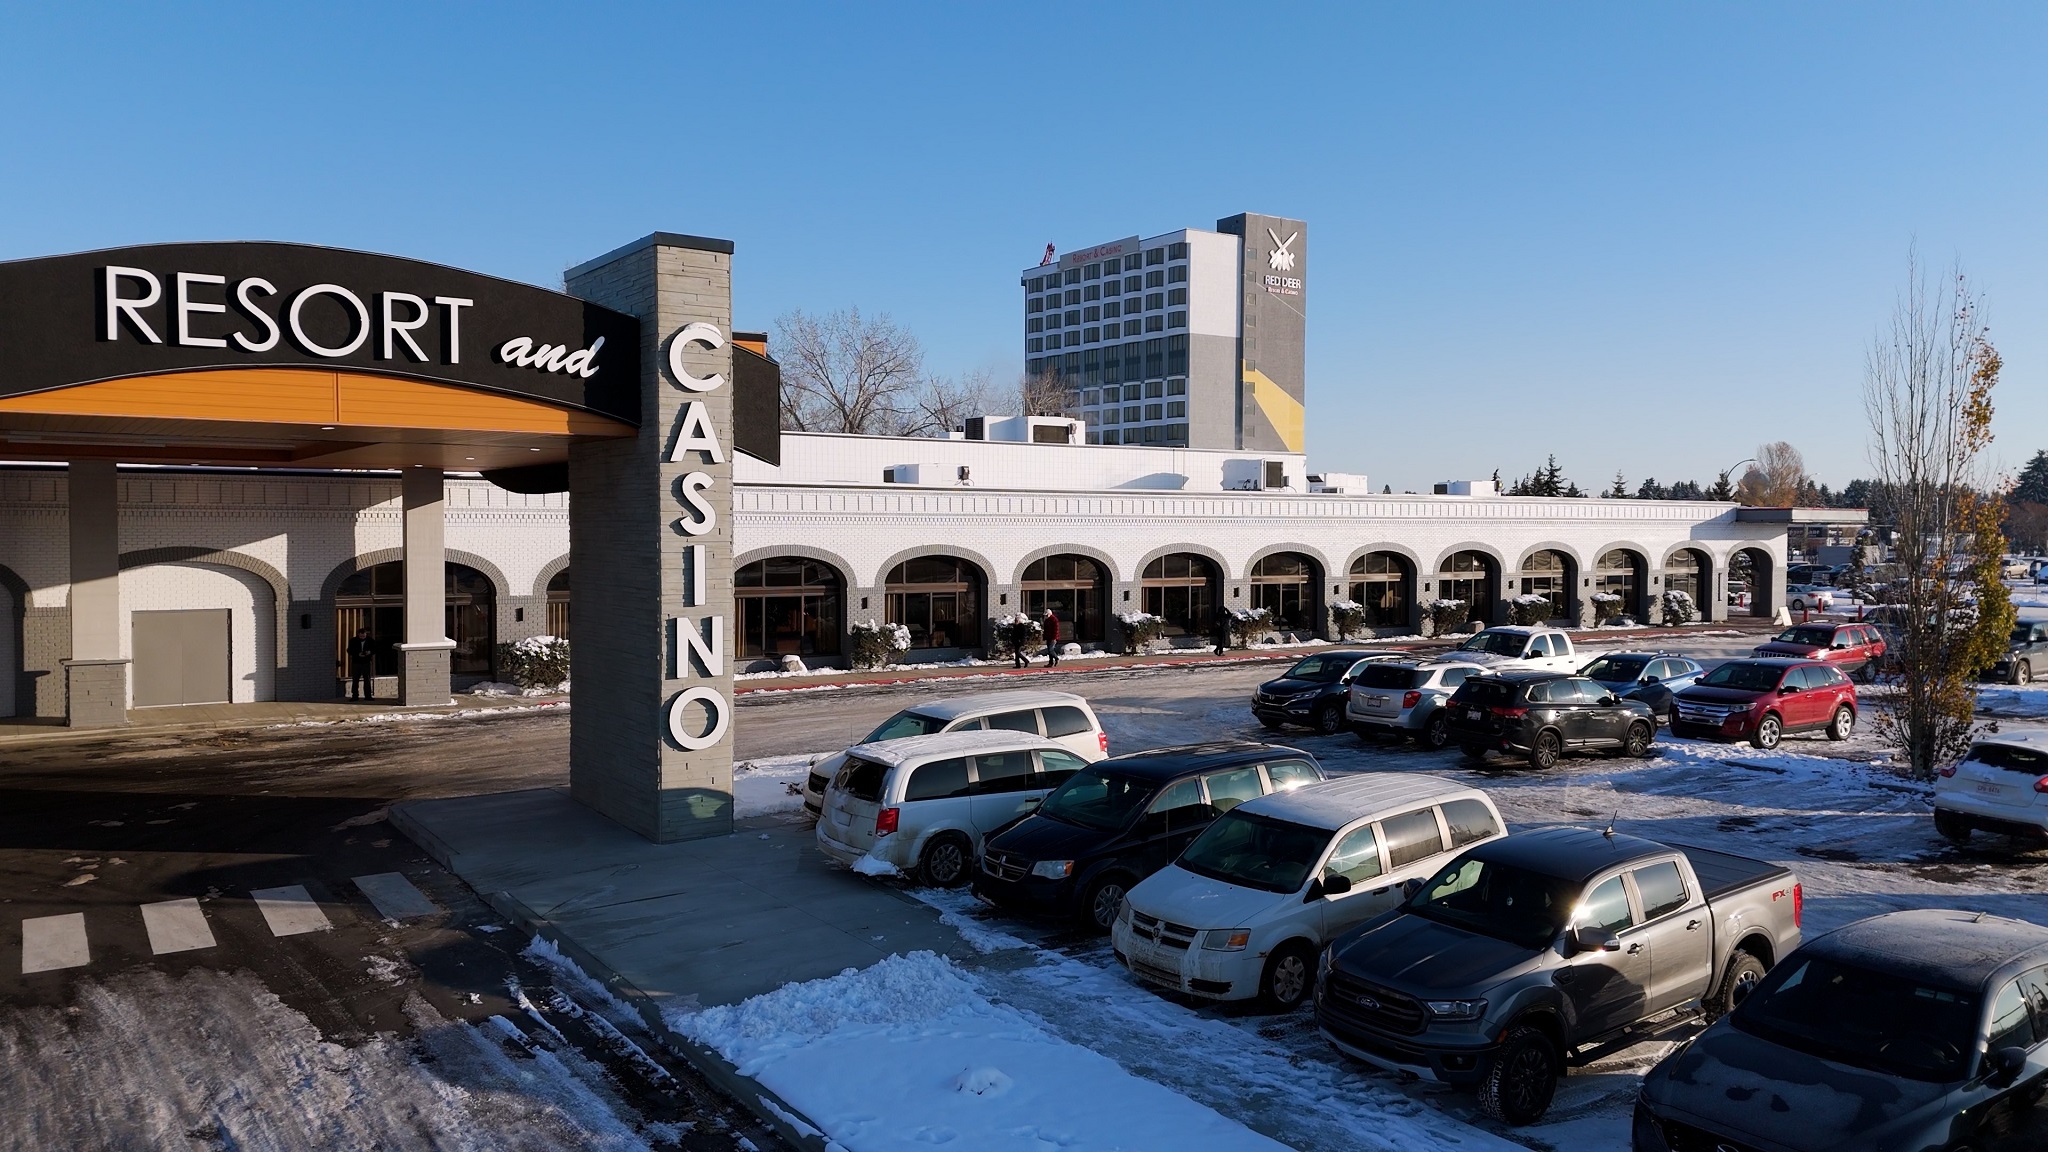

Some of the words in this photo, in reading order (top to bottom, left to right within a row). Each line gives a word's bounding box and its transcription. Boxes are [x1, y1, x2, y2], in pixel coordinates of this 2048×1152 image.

[1093, 248, 1099, 258] &
[1265, 275, 1281, 286] RED
[1282, 277, 1301, 289] DEER
[106, 265, 474, 364] RESORT
[500, 336, 606, 378] and
[669, 323, 730, 750] CASINO
